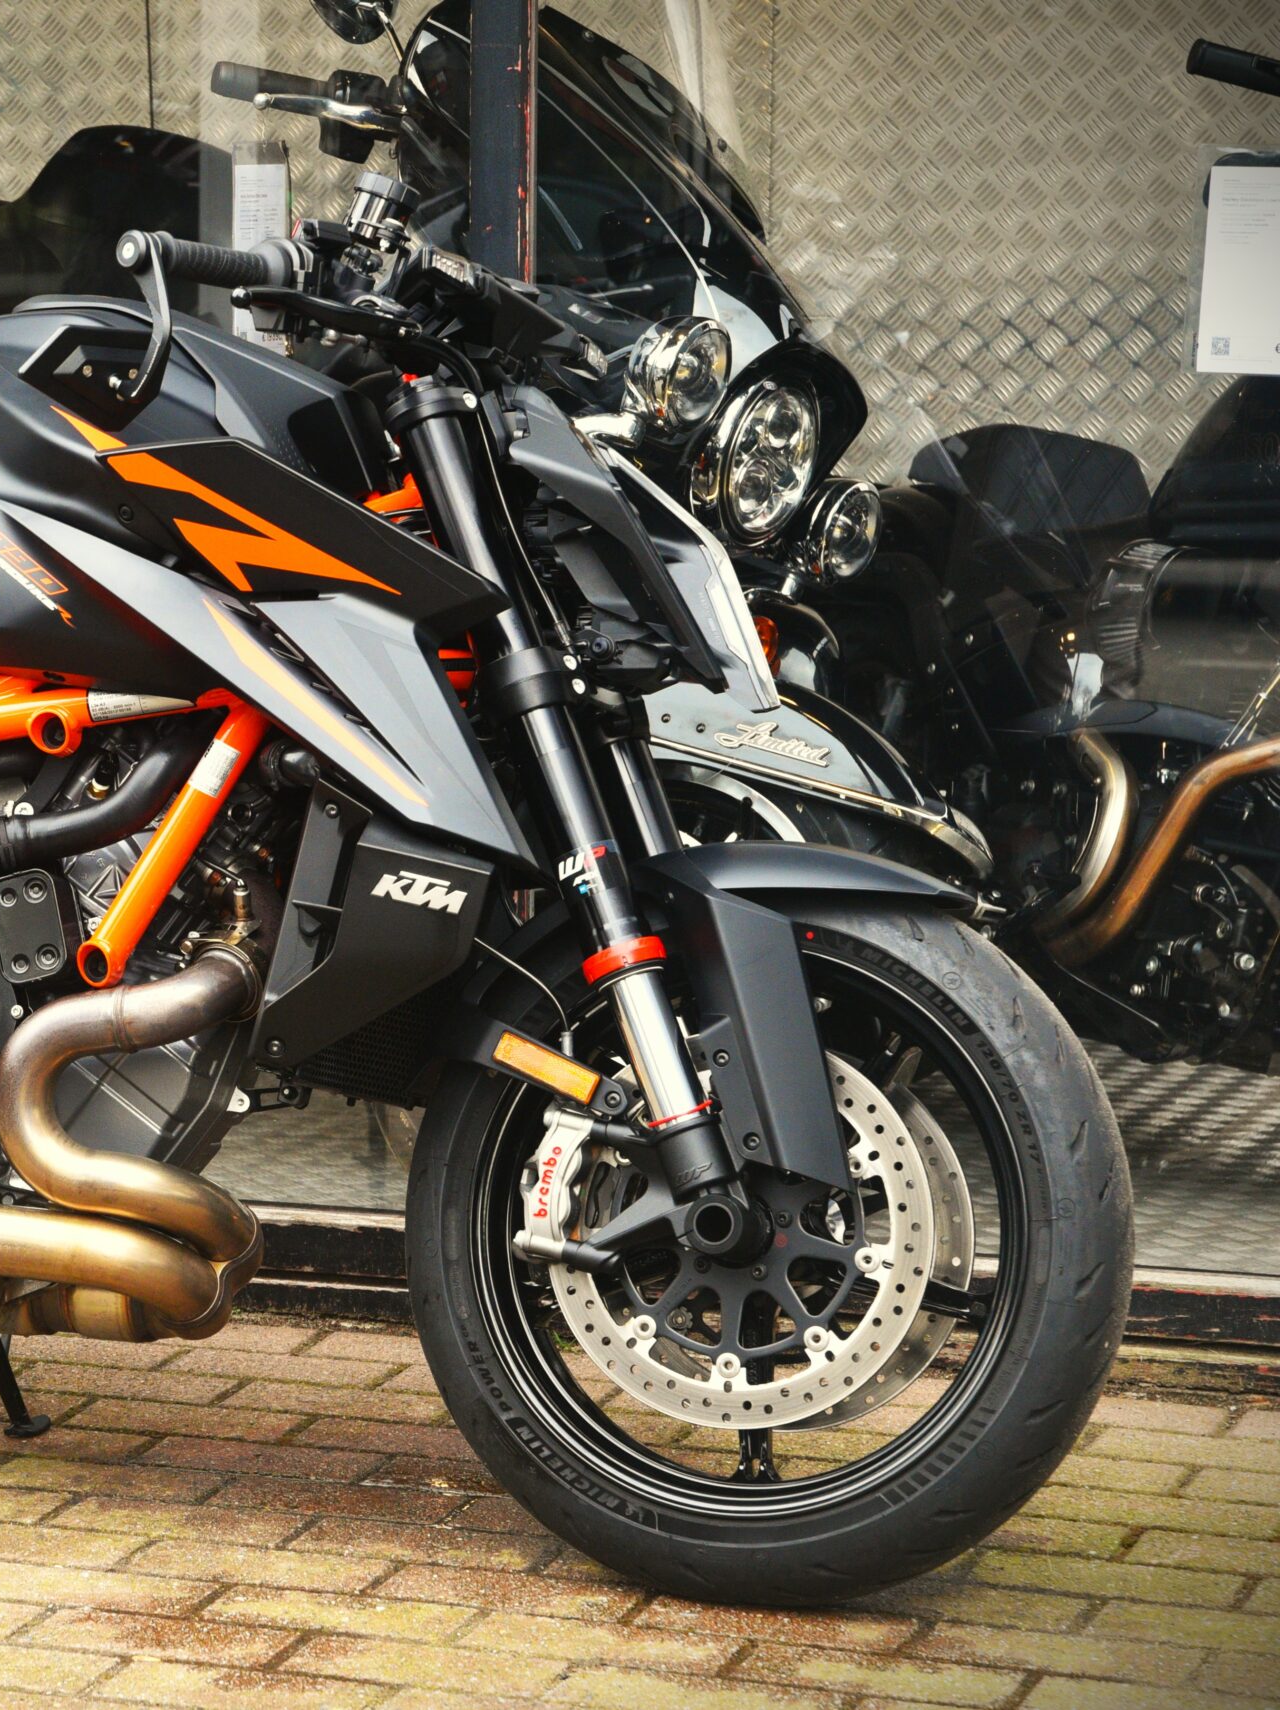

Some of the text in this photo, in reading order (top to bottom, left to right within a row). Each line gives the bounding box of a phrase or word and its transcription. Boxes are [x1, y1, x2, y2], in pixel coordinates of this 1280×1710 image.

[713, 720, 832, 768] Limited
[370, 870, 468, 915] KTM
[860, 946, 970, 1029] MICHELIN
[976, 1038, 1019, 1104] 120/70
[533, 1146, 563, 1220] brembo
[468, 1338, 514, 1414] POWER
[515, 1424, 619, 1510] MICHELIN
